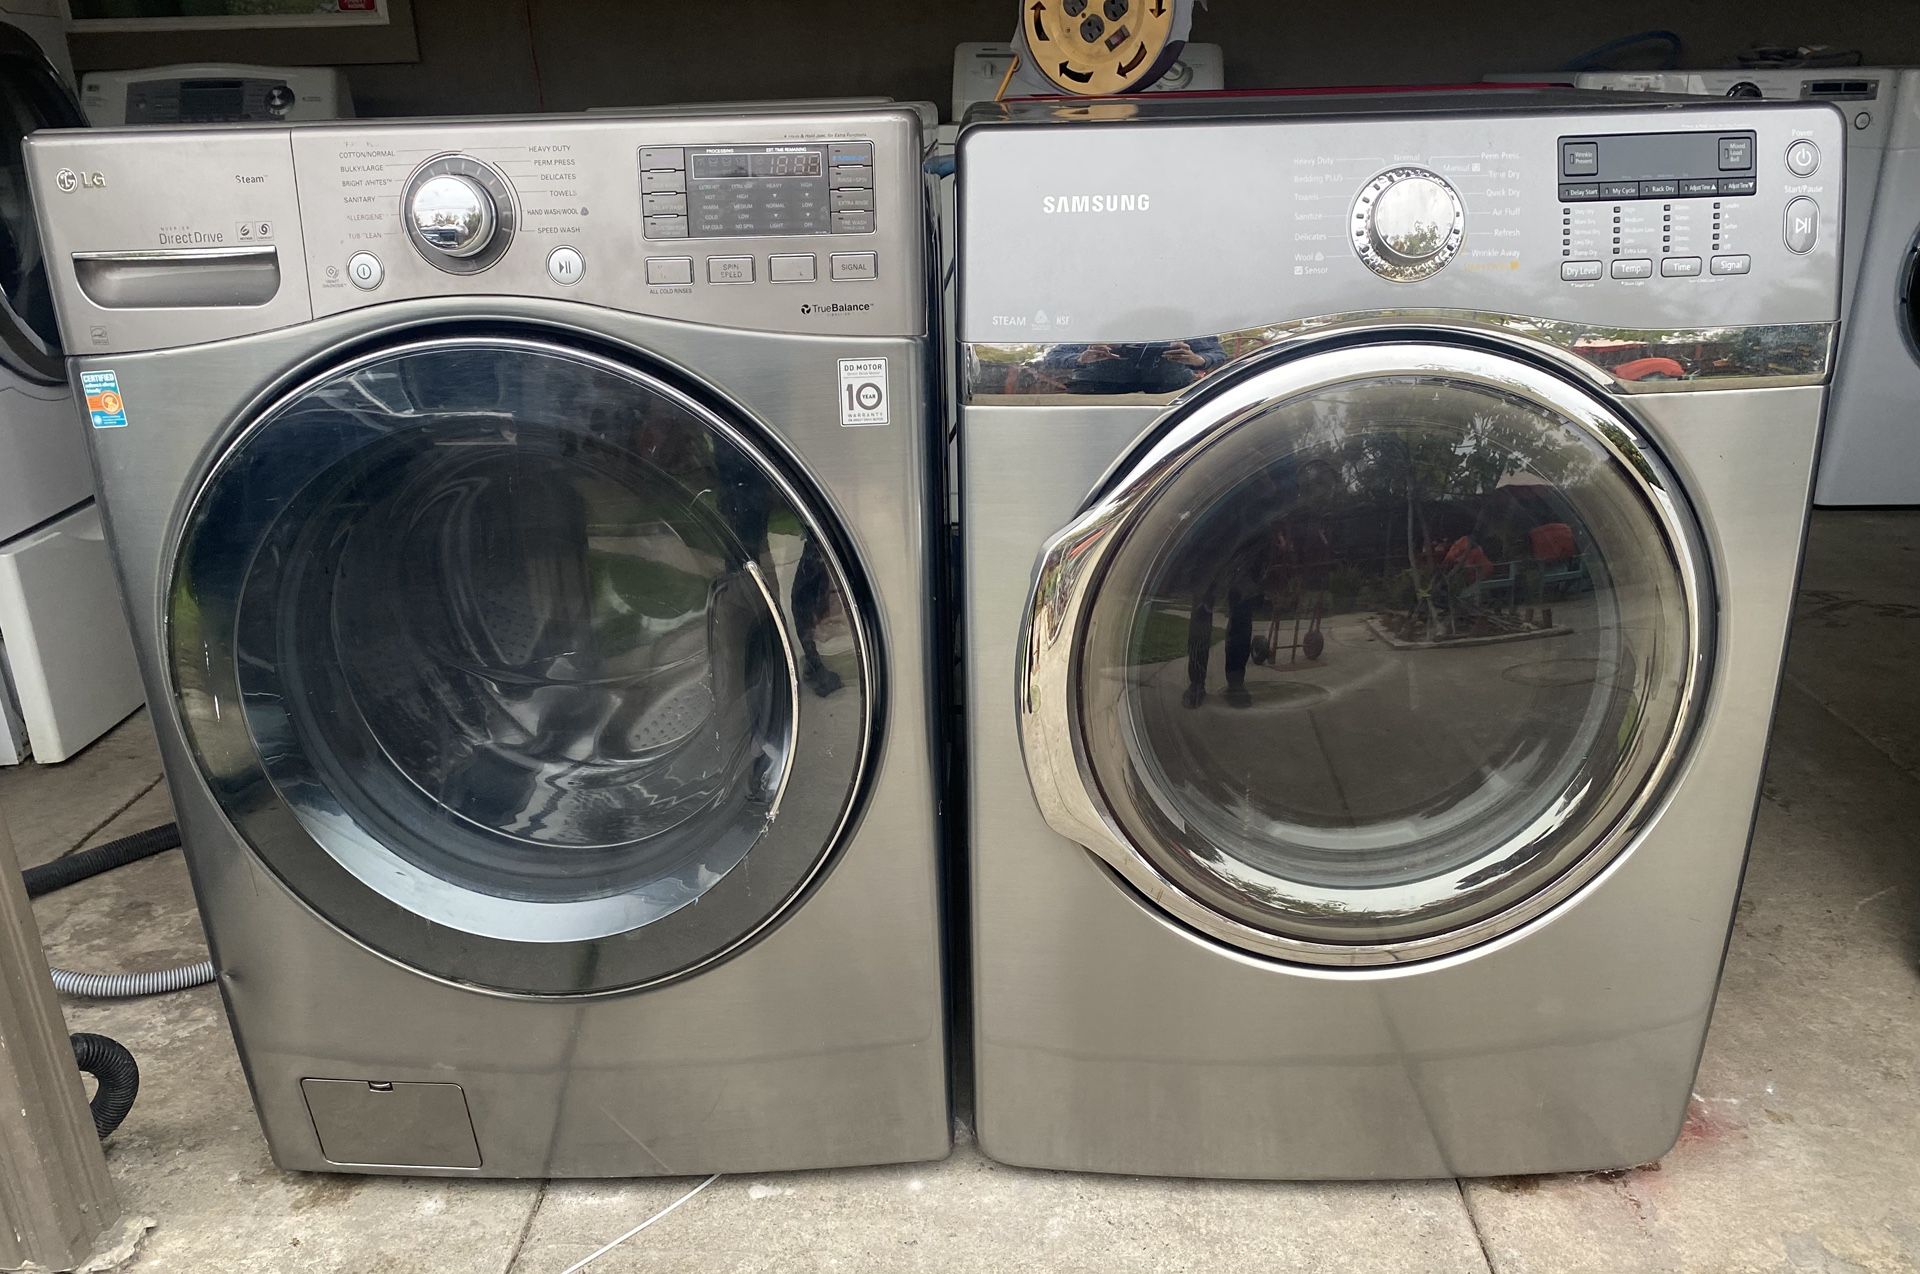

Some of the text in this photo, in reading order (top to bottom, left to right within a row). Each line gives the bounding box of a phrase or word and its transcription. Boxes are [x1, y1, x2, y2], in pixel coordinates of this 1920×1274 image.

[1791, 128, 1814, 137] Power
[339, 150, 395, 159] COTTON/NORMAL
[340, 164, 384, 173] BULKY/LARGE
[540, 173, 577, 181] DELICATES
[1507, 170, 1520, 179] Dry
[80, 171, 106, 188] LG
[1508, 188, 1520, 198] Dry
[1570, 189, 1585, 197] Delay
[1665, 185, 1674, 193] Dry
[1043, 194, 1150, 214] SAMSUNG
[722, 263, 739, 271] SPIN
[841, 263, 868, 271] SIGNAL
[1621, 264, 1643, 274] Temp.
[1673, 262, 1691, 271] Time
[1720, 260, 1743, 271] Signal
[1566, 265, 1598, 277] Dry Level
[812, 303, 870, 313] TrueBalance
[992, 315, 1026, 326] STEAM
[1056, 315, 1070, 325] NSF
[856, 363, 882, 371] MOTOR
